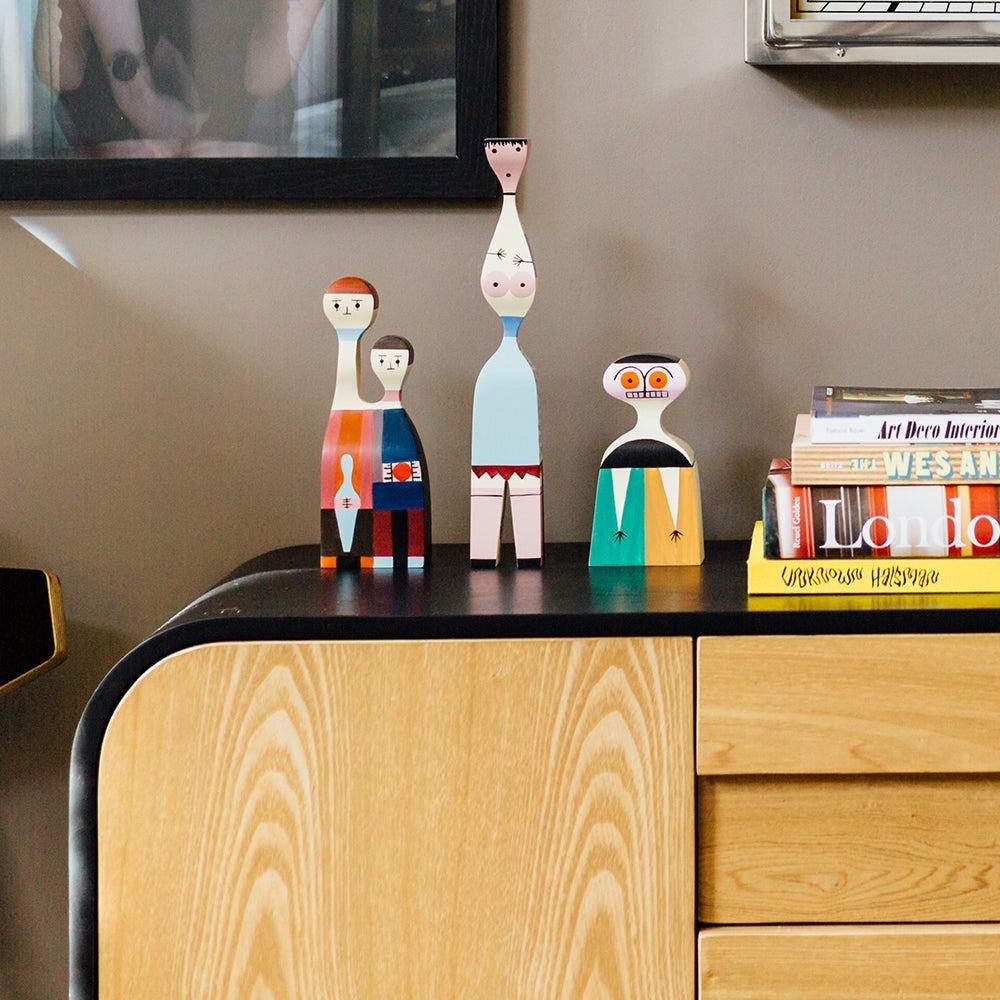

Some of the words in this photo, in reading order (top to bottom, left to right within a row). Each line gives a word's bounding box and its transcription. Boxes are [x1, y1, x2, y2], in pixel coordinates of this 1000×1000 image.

[877, 420, 902, 440] Art
[905, 420, 941, 440] Deco
[849, 456, 876, 471] THE
[882, 449, 954, 481] WES
[791, 496, 801, 525] Golden
